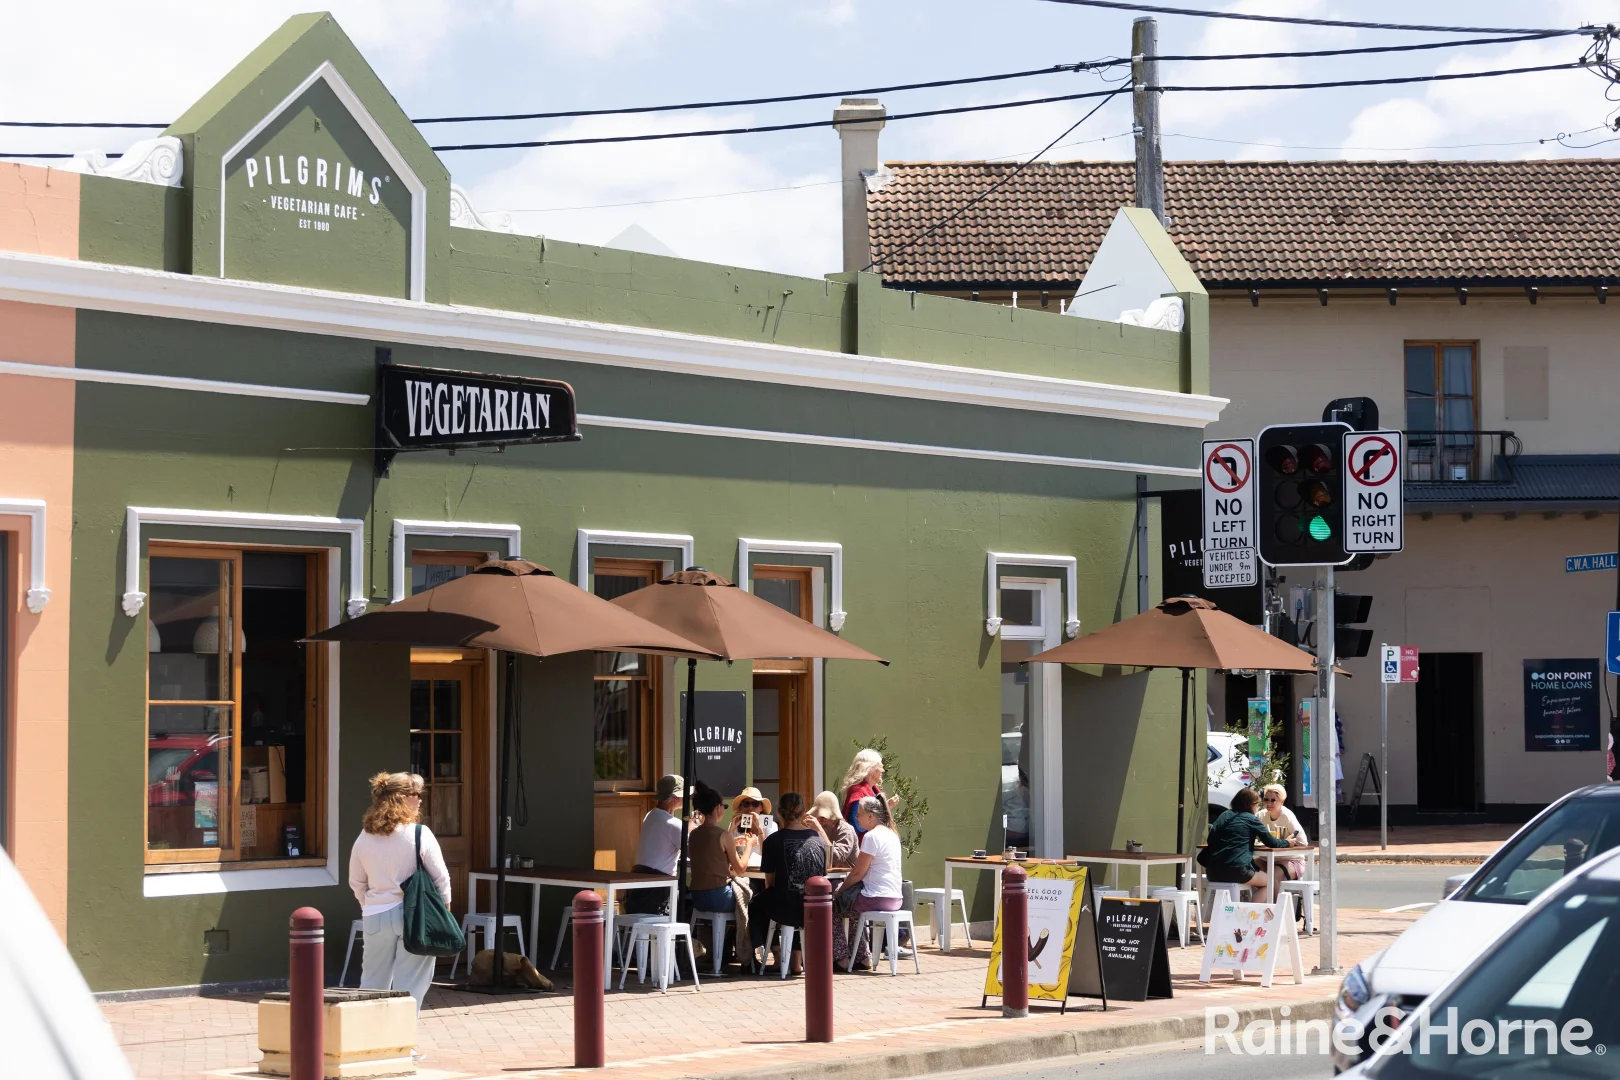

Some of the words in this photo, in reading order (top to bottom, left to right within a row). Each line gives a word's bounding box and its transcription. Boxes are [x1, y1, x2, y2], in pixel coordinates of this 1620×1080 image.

[270, 195, 330, 216] VEGETARIAN
[334, 204, 358, 220] CAFE
[299, 218, 311, 230] EST
[313, 220, 330, 232] 1980
[405, 380, 551, 437] VEGETARIAN
[1215, 498, 1242, 516] NO
[1358, 491, 1388, 510] NO
[1212, 520, 1246, 533] LEFT
[1352, 514, 1396, 527] RIGHT
[1211, 536, 1247, 549] TURN
[1353, 531, 1393, 544] TURN
[1209, 550, 1250, 561] VEHICLES
[1209, 563, 1233, 572] UNDER
[1239, 562, 1251, 570] 9m
[1566, 557, 1590, 571] C.W.A.
[1592, 555, 1617, 569] HALL
[1209, 573, 1251, 584] EXCEPTED
[1387, 650, 1395, 660] P
[1546, 672, 1562, 680] ON
[1564, 671, 1592, 680] POINT
[1531, 681, 1560, 690] HOME
[1561, 680, 1592, 689] LOANS
[693, 726, 742, 744] ILGRIMS
[763, 817, 769, 826] 6
[1106, 914, 1149, 925] PILGRIMS
[1108, 952, 1136, 960] AVAILABLE
